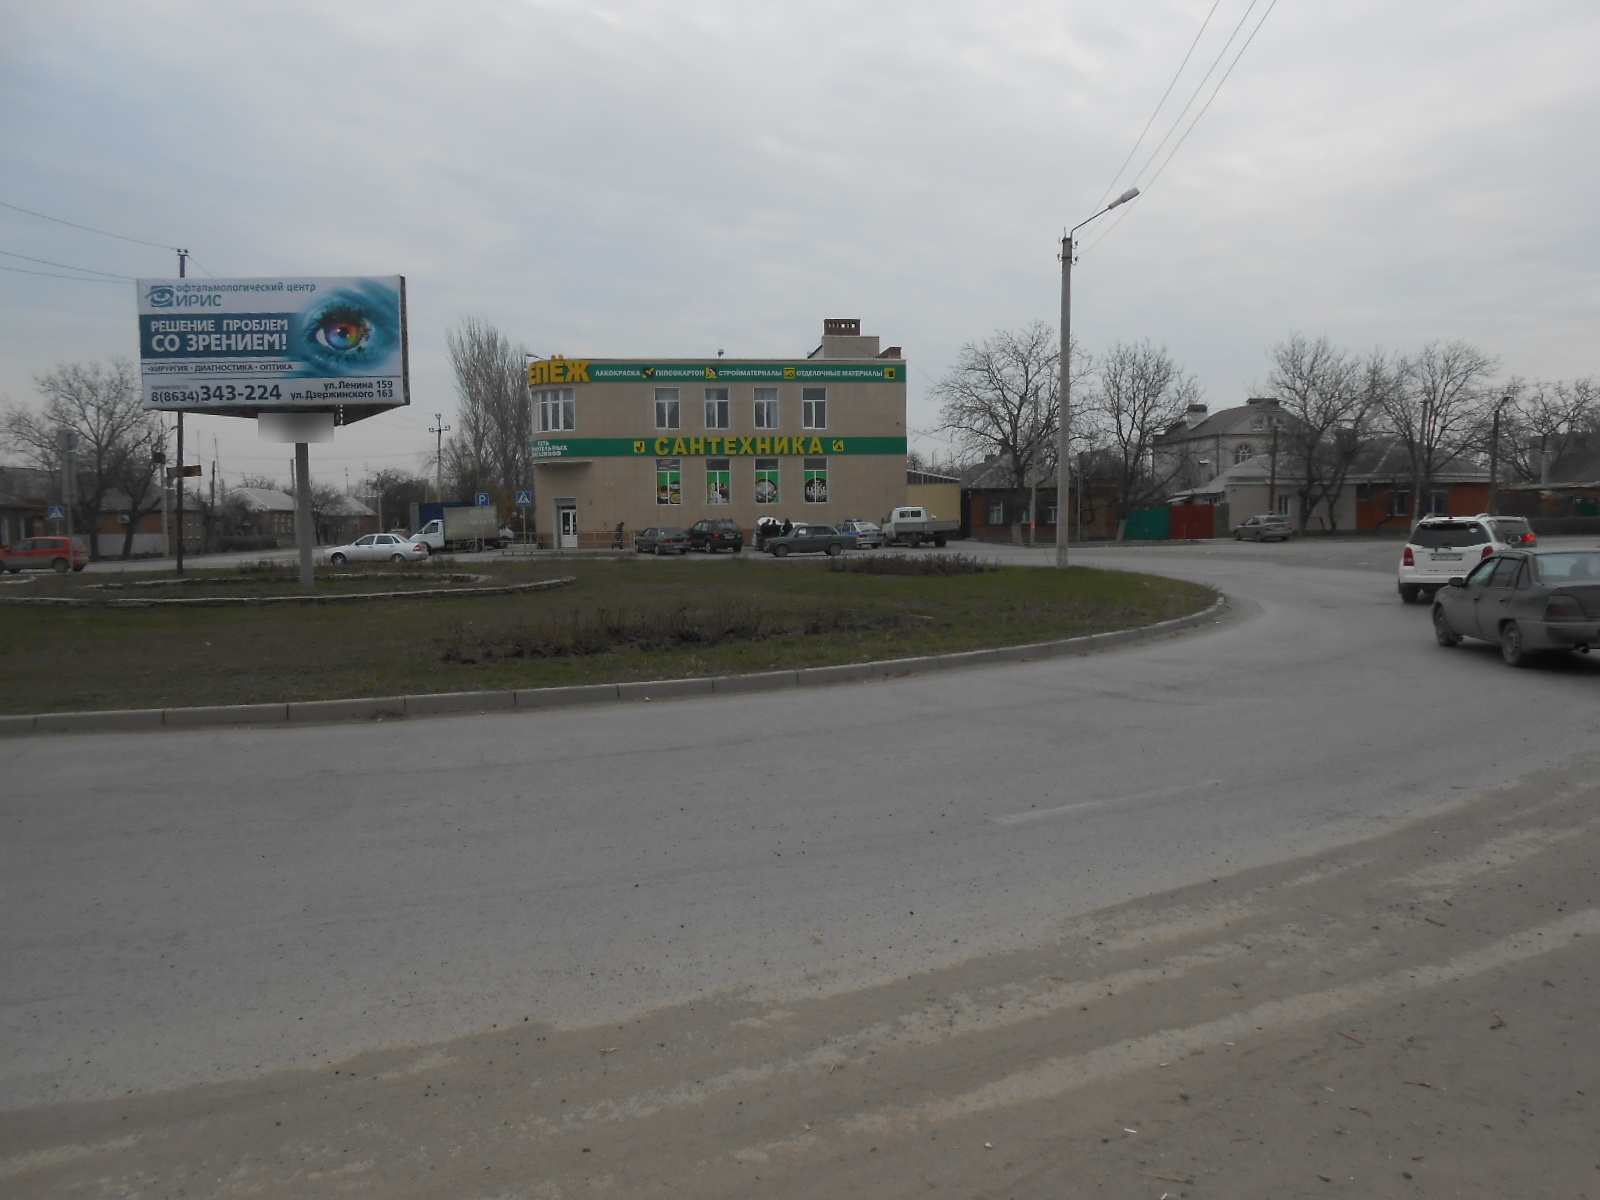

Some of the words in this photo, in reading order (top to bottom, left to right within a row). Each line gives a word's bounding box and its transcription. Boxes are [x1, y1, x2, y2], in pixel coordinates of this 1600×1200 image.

[176, 283, 284, 293] офтальмологический
[286, 283, 316, 292] центр
[176, 294, 222, 307] ИРИС
[151, 320, 216, 332] РЕШЕНИЕ
[223, 319, 289, 331] ПРОБЛЕМ
[152, 334, 181, 352] СО
[186, 333, 287, 351] ЗРЕНИЕМ!
[195, 364, 253, 372] ДИАГНОСТИКА
[718, 368, 783, 377] СТРОЙМАТЕРИАЛЫ
[595, 369, 641, 377] ЛАКОКРАСКА
[655, 369, 705, 377] ГИПСОКАРТОН
[796, 370, 842, 378] ОТДЕЛОЧНЫЕ
[841, 370, 883, 378] МАТЕРИАЛЫ
[376, 380, 393, 389] 159
[377, 389, 393, 398] 163
[654, 436, 824, 456] САНТЕХНИКА
